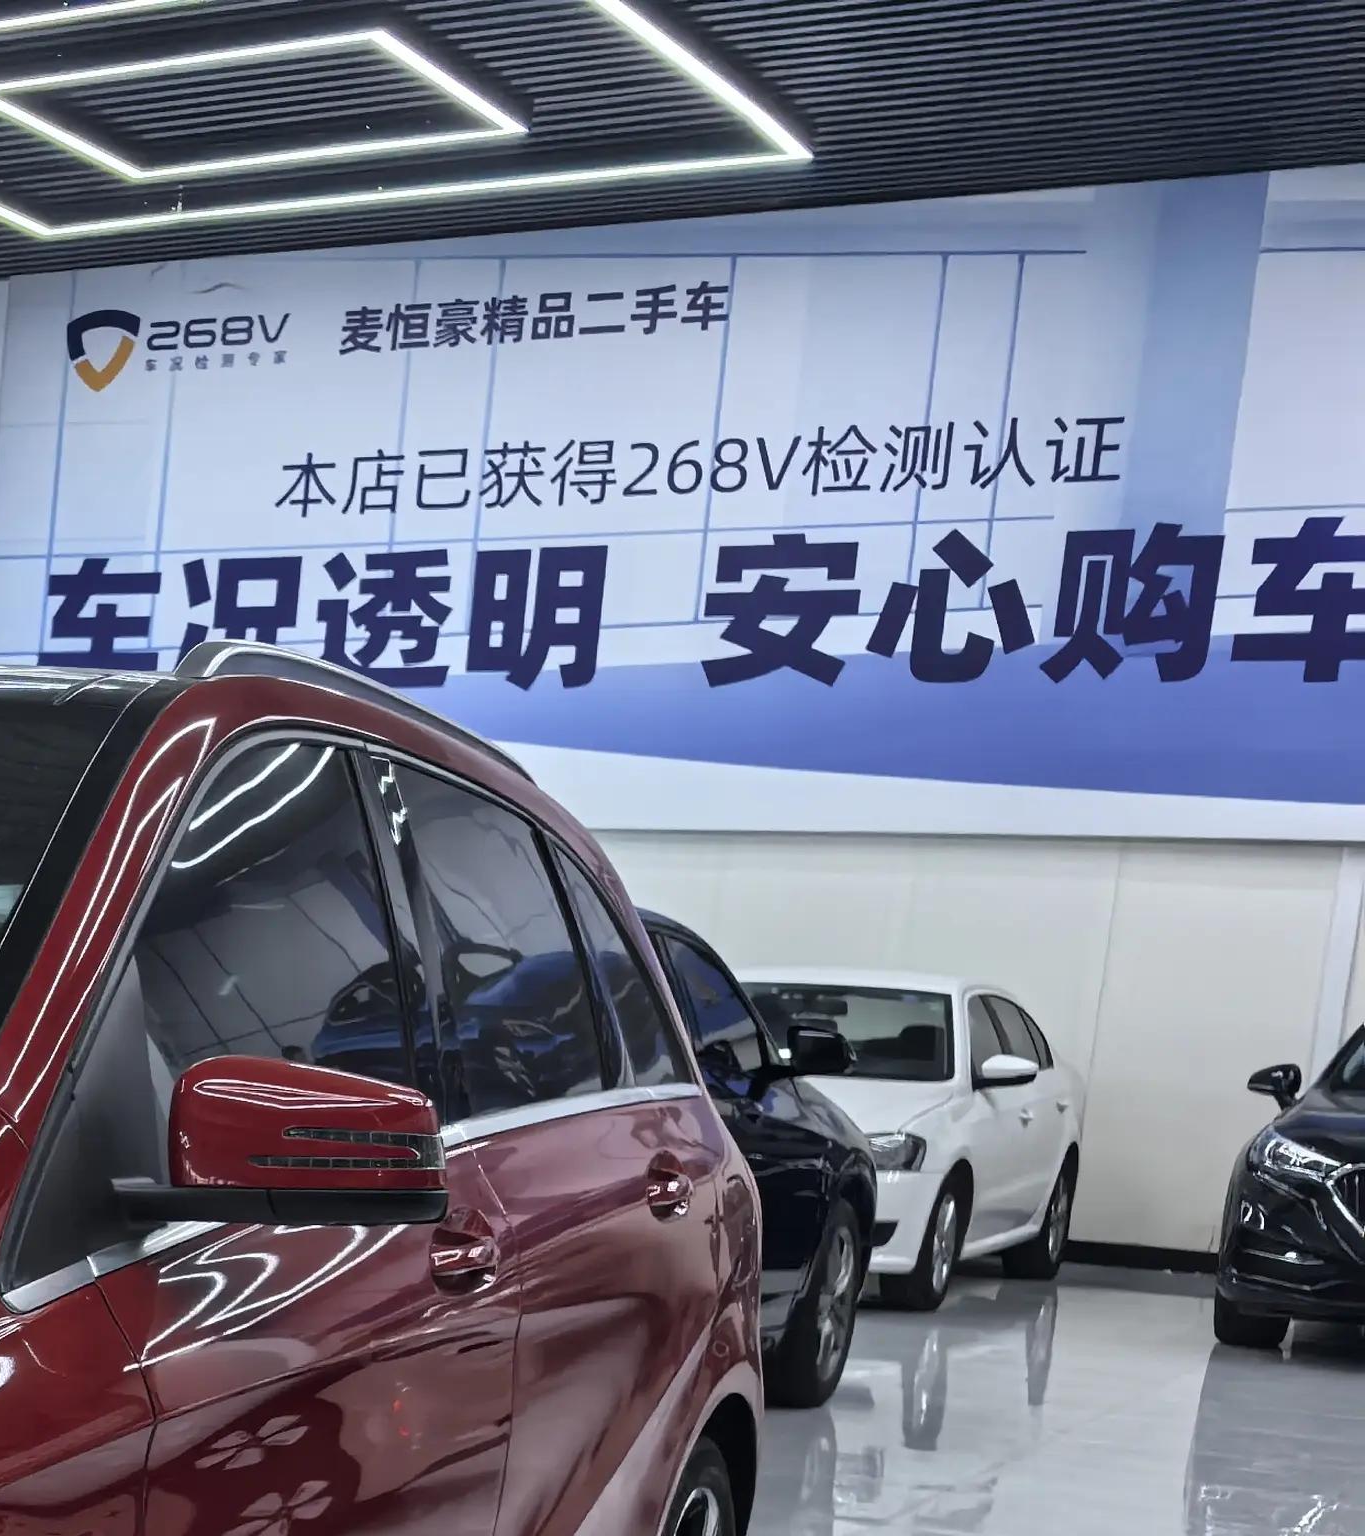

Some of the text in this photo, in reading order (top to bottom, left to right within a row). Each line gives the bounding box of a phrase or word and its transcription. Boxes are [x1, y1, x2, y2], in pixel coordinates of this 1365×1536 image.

[146, 312, 292, 351] 268V
[339, 280, 730, 356] 麦恒豪精品二手车
[274, 414, 1128, 518] 本店已获得268V检测认证
[37, 515, 1365, 692] 车况透明 安心购车
